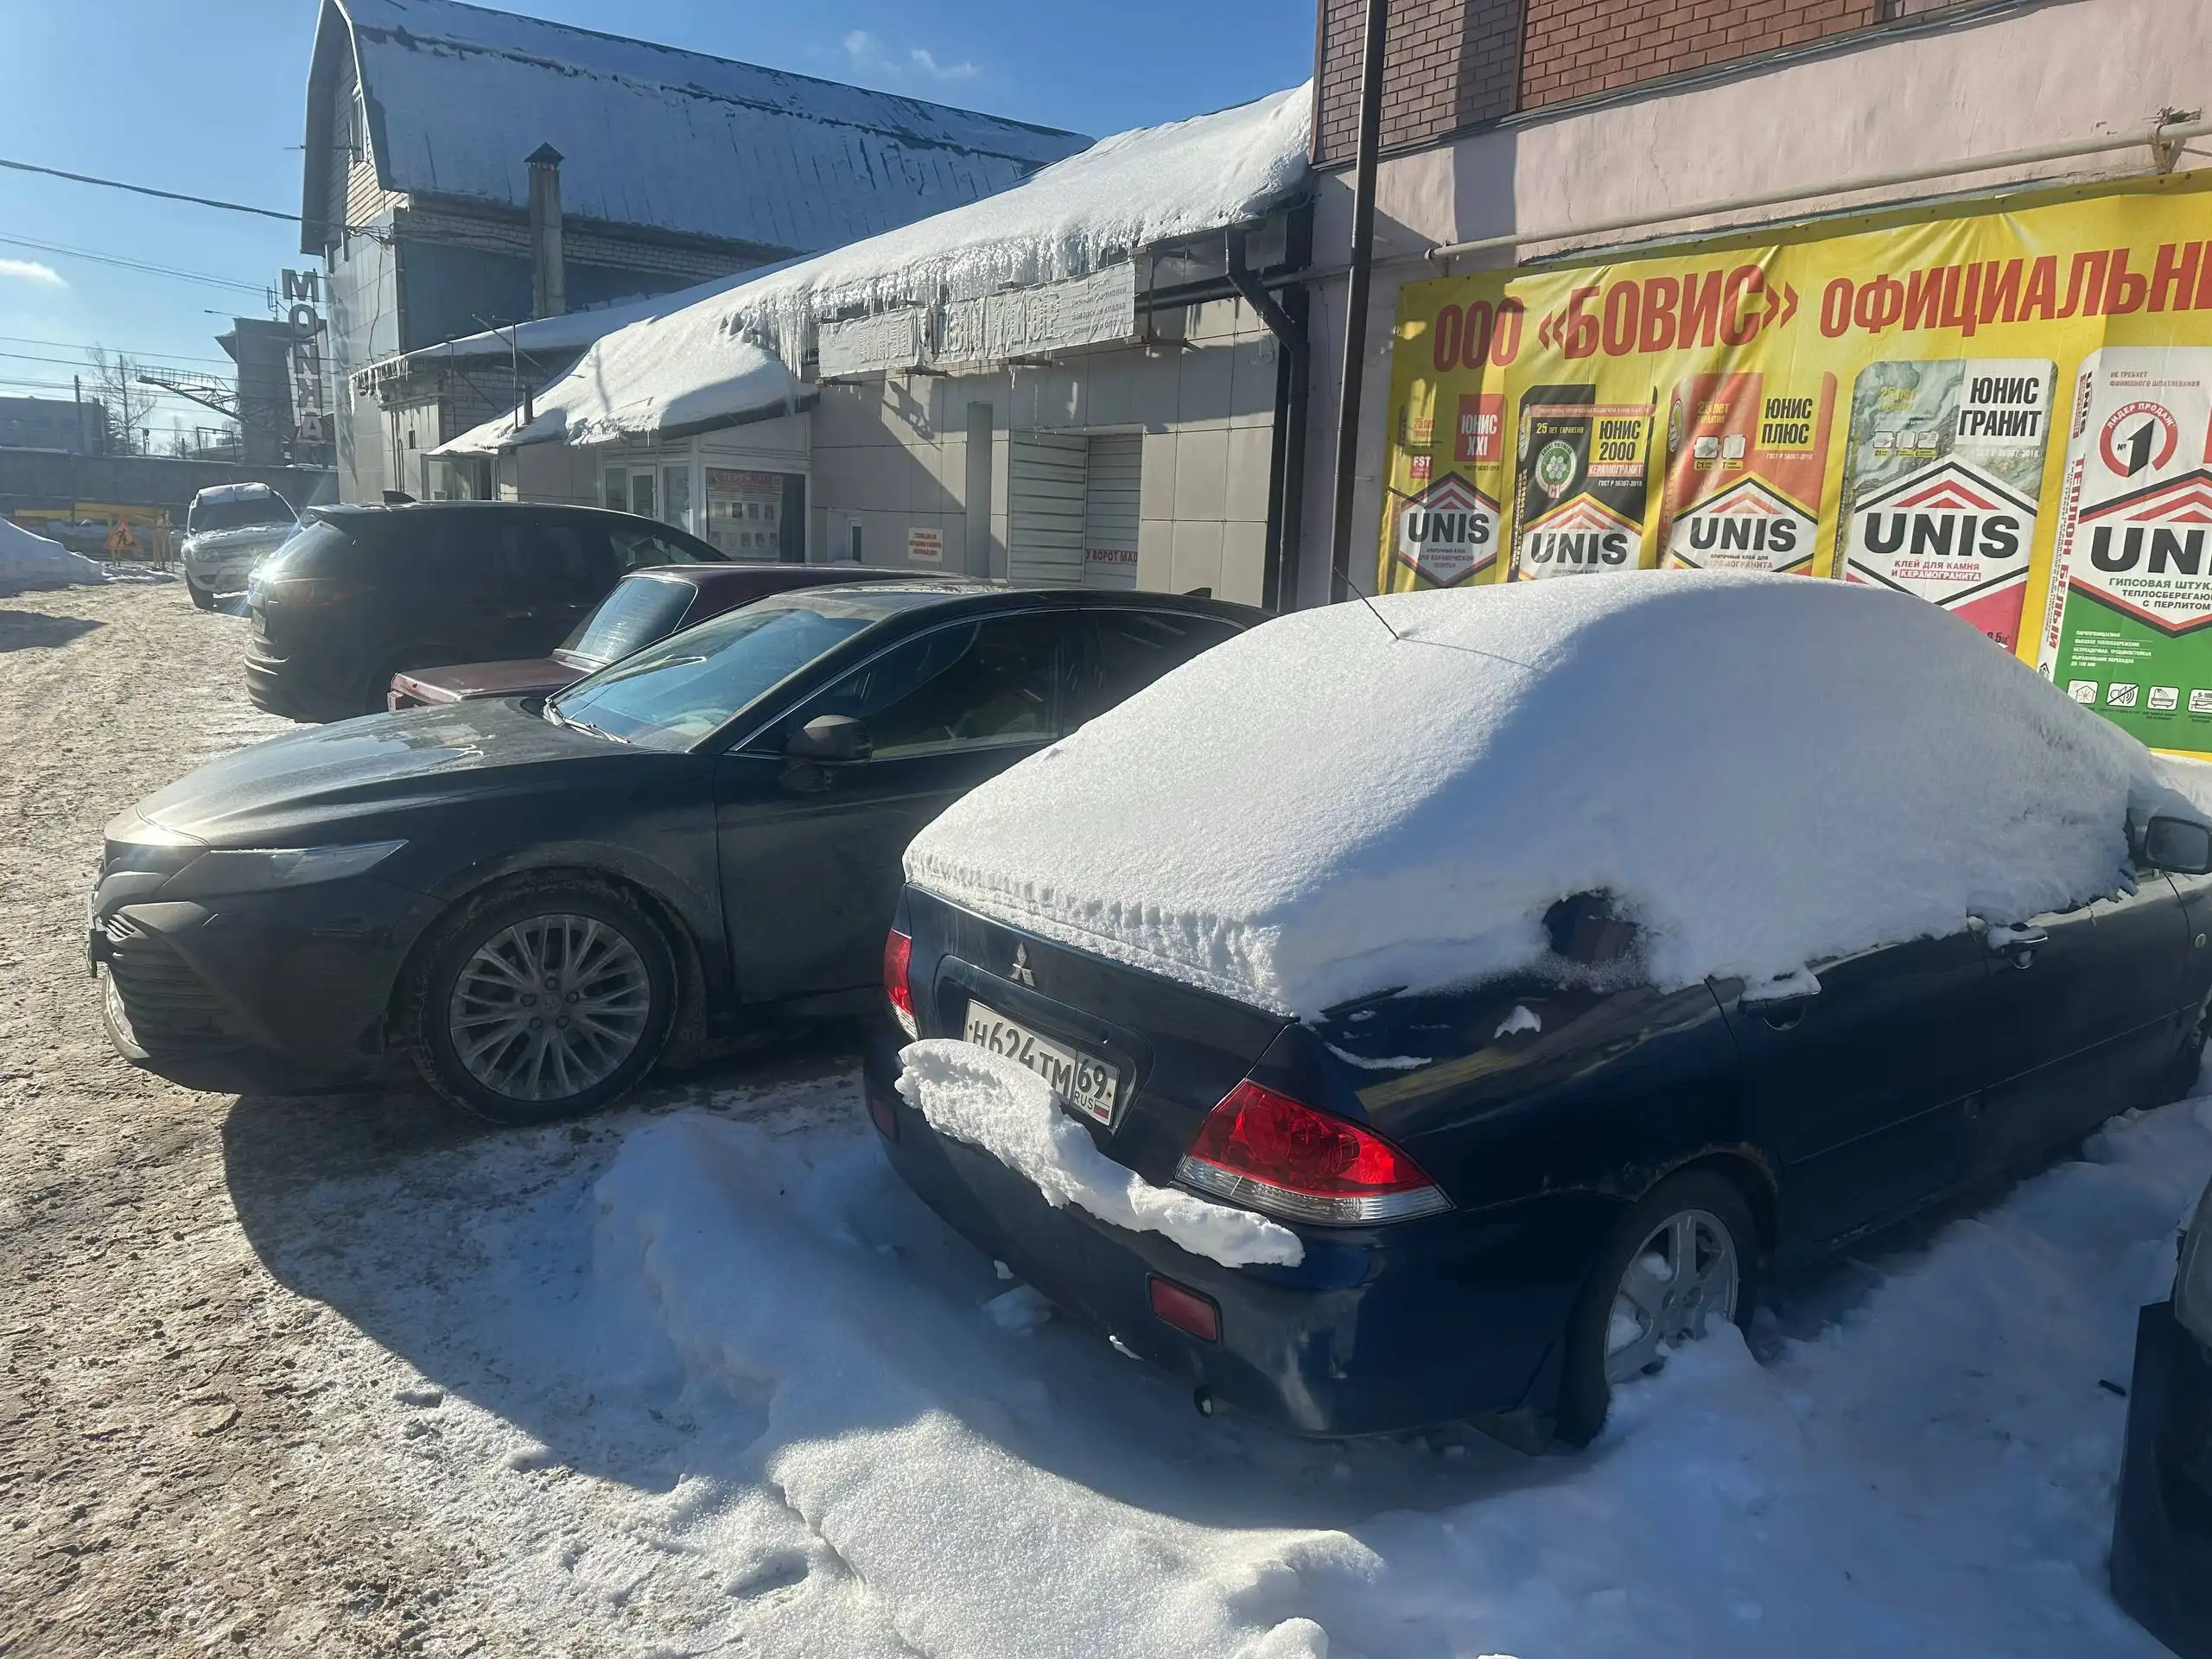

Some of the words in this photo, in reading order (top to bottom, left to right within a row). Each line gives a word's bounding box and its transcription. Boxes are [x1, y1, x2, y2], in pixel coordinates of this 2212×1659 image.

[1433, 296, 1523, 372] ООО
[1538, 264, 1799, 360] «БОВИС»
[1969, 377, 2039, 404] ЮНИС
[1765, 397, 1813, 419] ЮНИС
[2108, 404, 2136, 429] ЛИДЕР
[1461, 415, 1497, 435] ЮНИС
[1536, 423, 1548, 434] 25
[1599, 420, 1641, 440] ЮНИС
[1762, 423, 1809, 444] ПЛЮС
[1958, 410, 2042, 437] ГРАНИТ
[1414, 456, 1431, 467] FST
[1599, 442, 1636, 461] 2000
[1589, 464, 1643, 477] КЕРАМОГРАНИТ
[2063, 454, 2085, 555] ТЕПЛОН
[1408, 512, 1490, 544] UNIS
[1689, 517, 1797, 552] UNIS
[1864, 512, 2019, 559] UNIS
[1086, 549, 1091, 560] У
[1093, 550, 1118, 562] ВОРОТ
[1530, 532, 1628, 565] UNIS
[2091, 526, 2212, 575] UN
[1894, 560, 1921, 569] КЛЕЙ
[1923, 562, 1944, 571] ДЛЯ
[1947, 562, 1980, 571] КАМНЯ
[1900, 571, 1980, 582] КЕРАМОГРАНИТА
[2109, 578, 2171, 588] ГИПСОВАЯ
[2175, 580, 2212, 591] ШТУК
[2122, 589, 2212, 601] ТЕПЛОСБЕРЕГАЮ
[2154, 601, 2211, 610] ПЕРЛИТОМ
[2049, 564, 2069, 650] БЕЛЫЙ
[1077, 1058, 1109, 1100] 69
[1073, 1090, 1094, 1110] RUS
